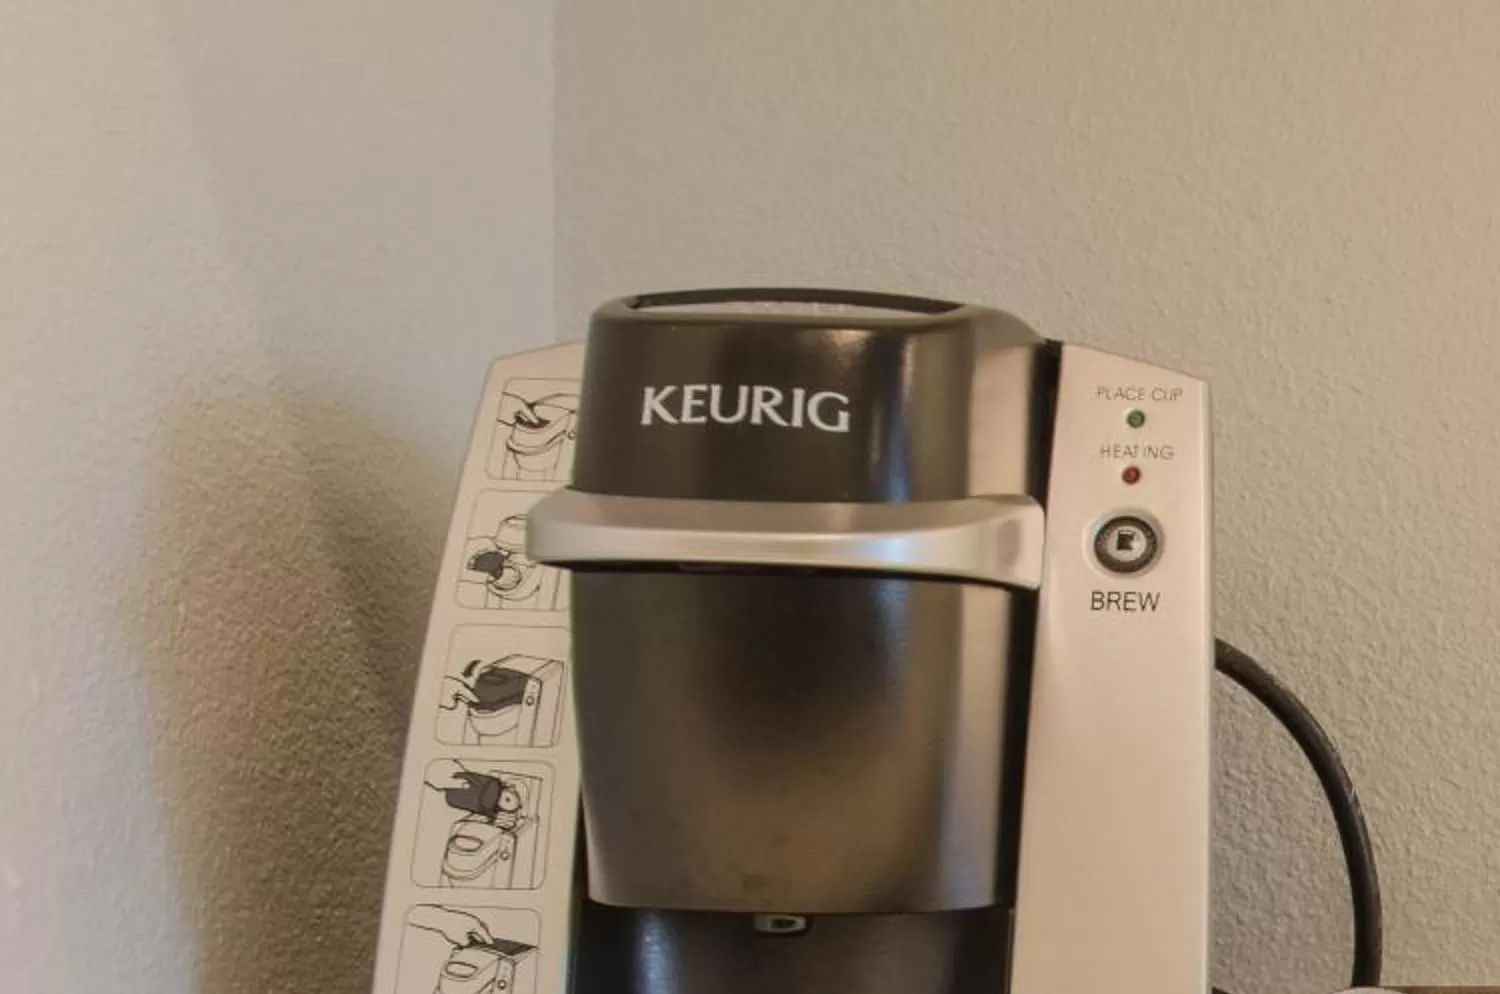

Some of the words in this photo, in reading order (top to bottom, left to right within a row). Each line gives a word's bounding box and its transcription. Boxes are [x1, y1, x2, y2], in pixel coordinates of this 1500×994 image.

[1097, 386, 1144, 401] PLACE
[1150, 387, 1183, 401] CUP
[640, 384, 851, 433] KEURIG
[1100, 444, 1175, 460] HEATING
[1090, 591, 1161, 612] BREW
